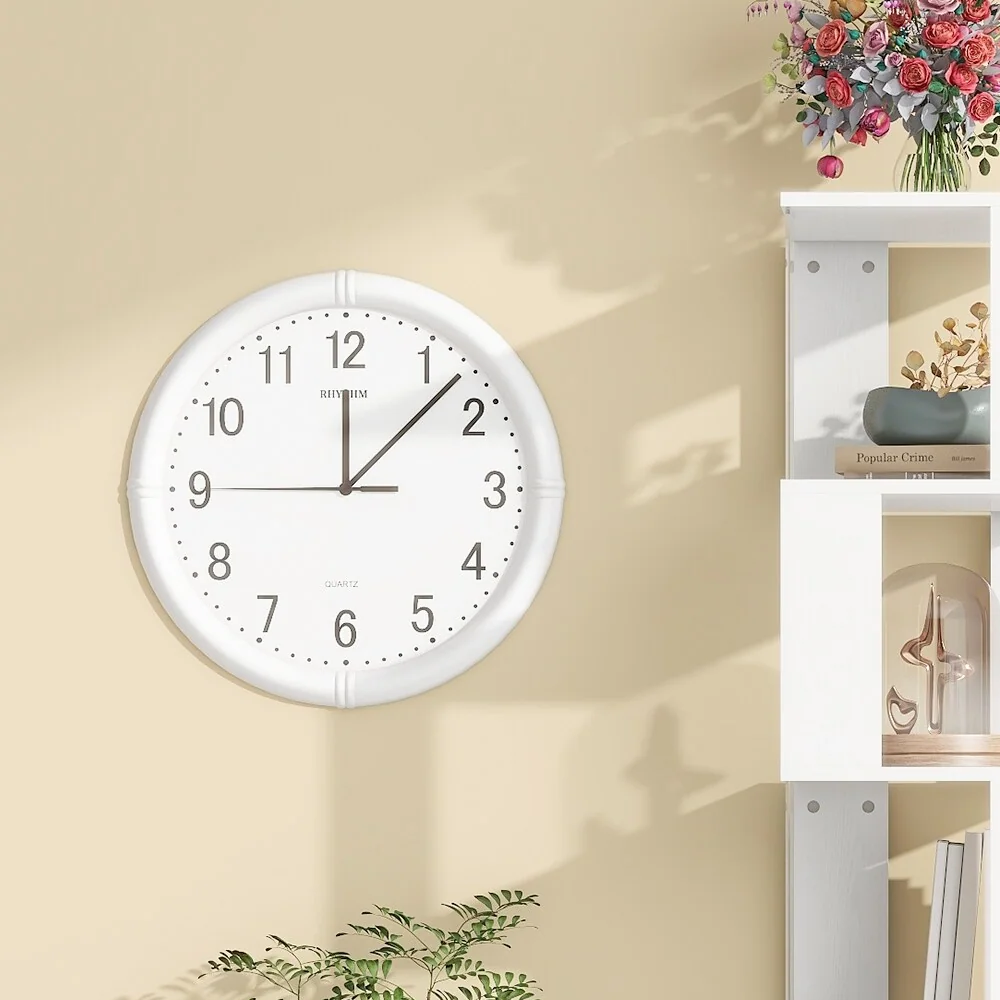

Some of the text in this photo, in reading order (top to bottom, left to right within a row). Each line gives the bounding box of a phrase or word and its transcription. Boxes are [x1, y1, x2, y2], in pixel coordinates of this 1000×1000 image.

[258, 345, 292, 384] 11
[325, 330, 366, 369] 12
[417, 345, 430, 384] 1
[319, 389, 369, 399] RHYHM
[202, 397, 244, 436] 10
[462, 397, 486, 437] 2
[856, 452, 899, 465] Popular
[901, 452, 934, 463] Crime
[188, 470, 212, 509] 9
[483, 470, 507, 509] 3
[208, 542, 231, 581] 8
[460, 542, 487, 581] 4
[324, 580, 359, 588] QUARTZ
[256, 594, 279, 633] 7
[334, 609, 357, 648] 6
[411, 594, 435, 633] 5
